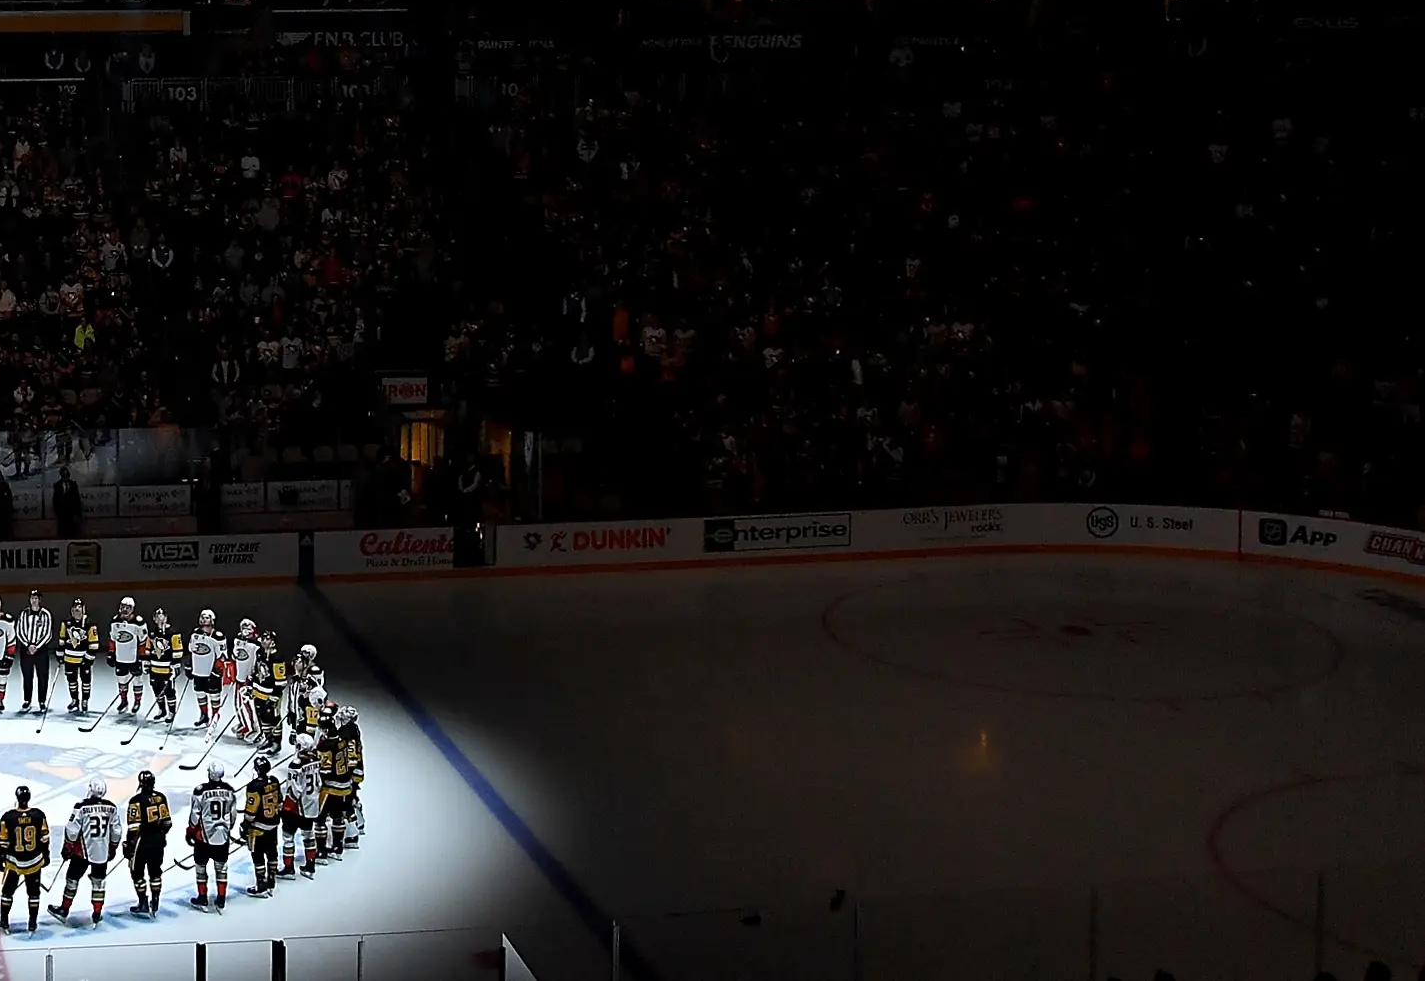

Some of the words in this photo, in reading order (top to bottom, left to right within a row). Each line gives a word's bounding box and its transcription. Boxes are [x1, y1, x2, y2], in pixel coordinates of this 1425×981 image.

[167, 86, 197, 101] 103
[1162, 517, 1193, 530] Steel
[574, 526, 671, 551] DUNKIN'
[711, 521, 848, 544] enterprise
[143, 543, 197, 561] MSA
[209, 542, 235, 554] EVERY
[237, 541, 261, 553] SAVE
[213, 553, 256, 565] MATTERS.
[401, 555, 425, 567] Draft
[14, 825, 37, 852] 19
